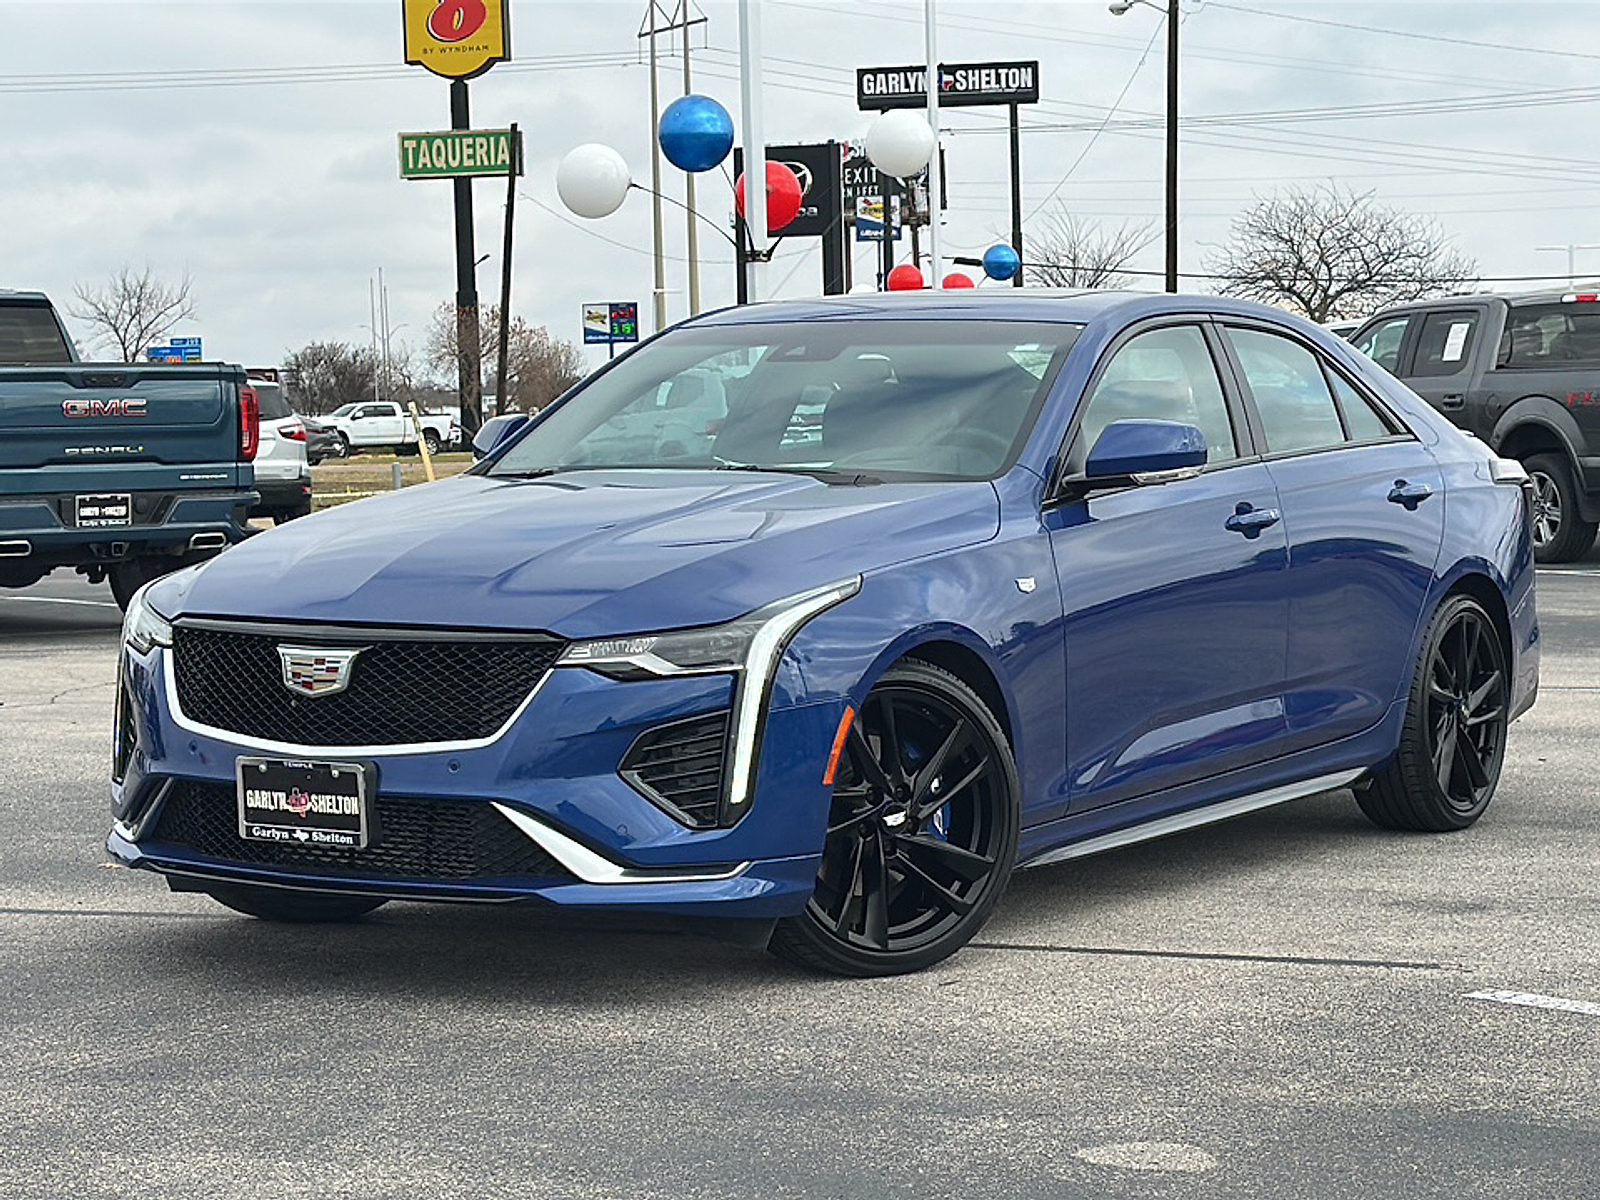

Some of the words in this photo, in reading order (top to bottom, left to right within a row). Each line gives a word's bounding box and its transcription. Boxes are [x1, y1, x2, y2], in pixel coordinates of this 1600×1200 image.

[439, 45, 489, 54] WYNDHAM
[862, 71, 928, 95] GARLYN
[954, 67, 1033, 91] SHELTON
[403, 136, 510, 170] TAQUERIA
[844, 166, 878, 184] EXIT
[62, 398, 147, 417] GMC
[246, 789, 289, 811] GARLYN
[310, 793, 360, 816] SHELTON
[252, 826, 290, 840] Garlyn
[312, 831, 354, 845] Shelton
